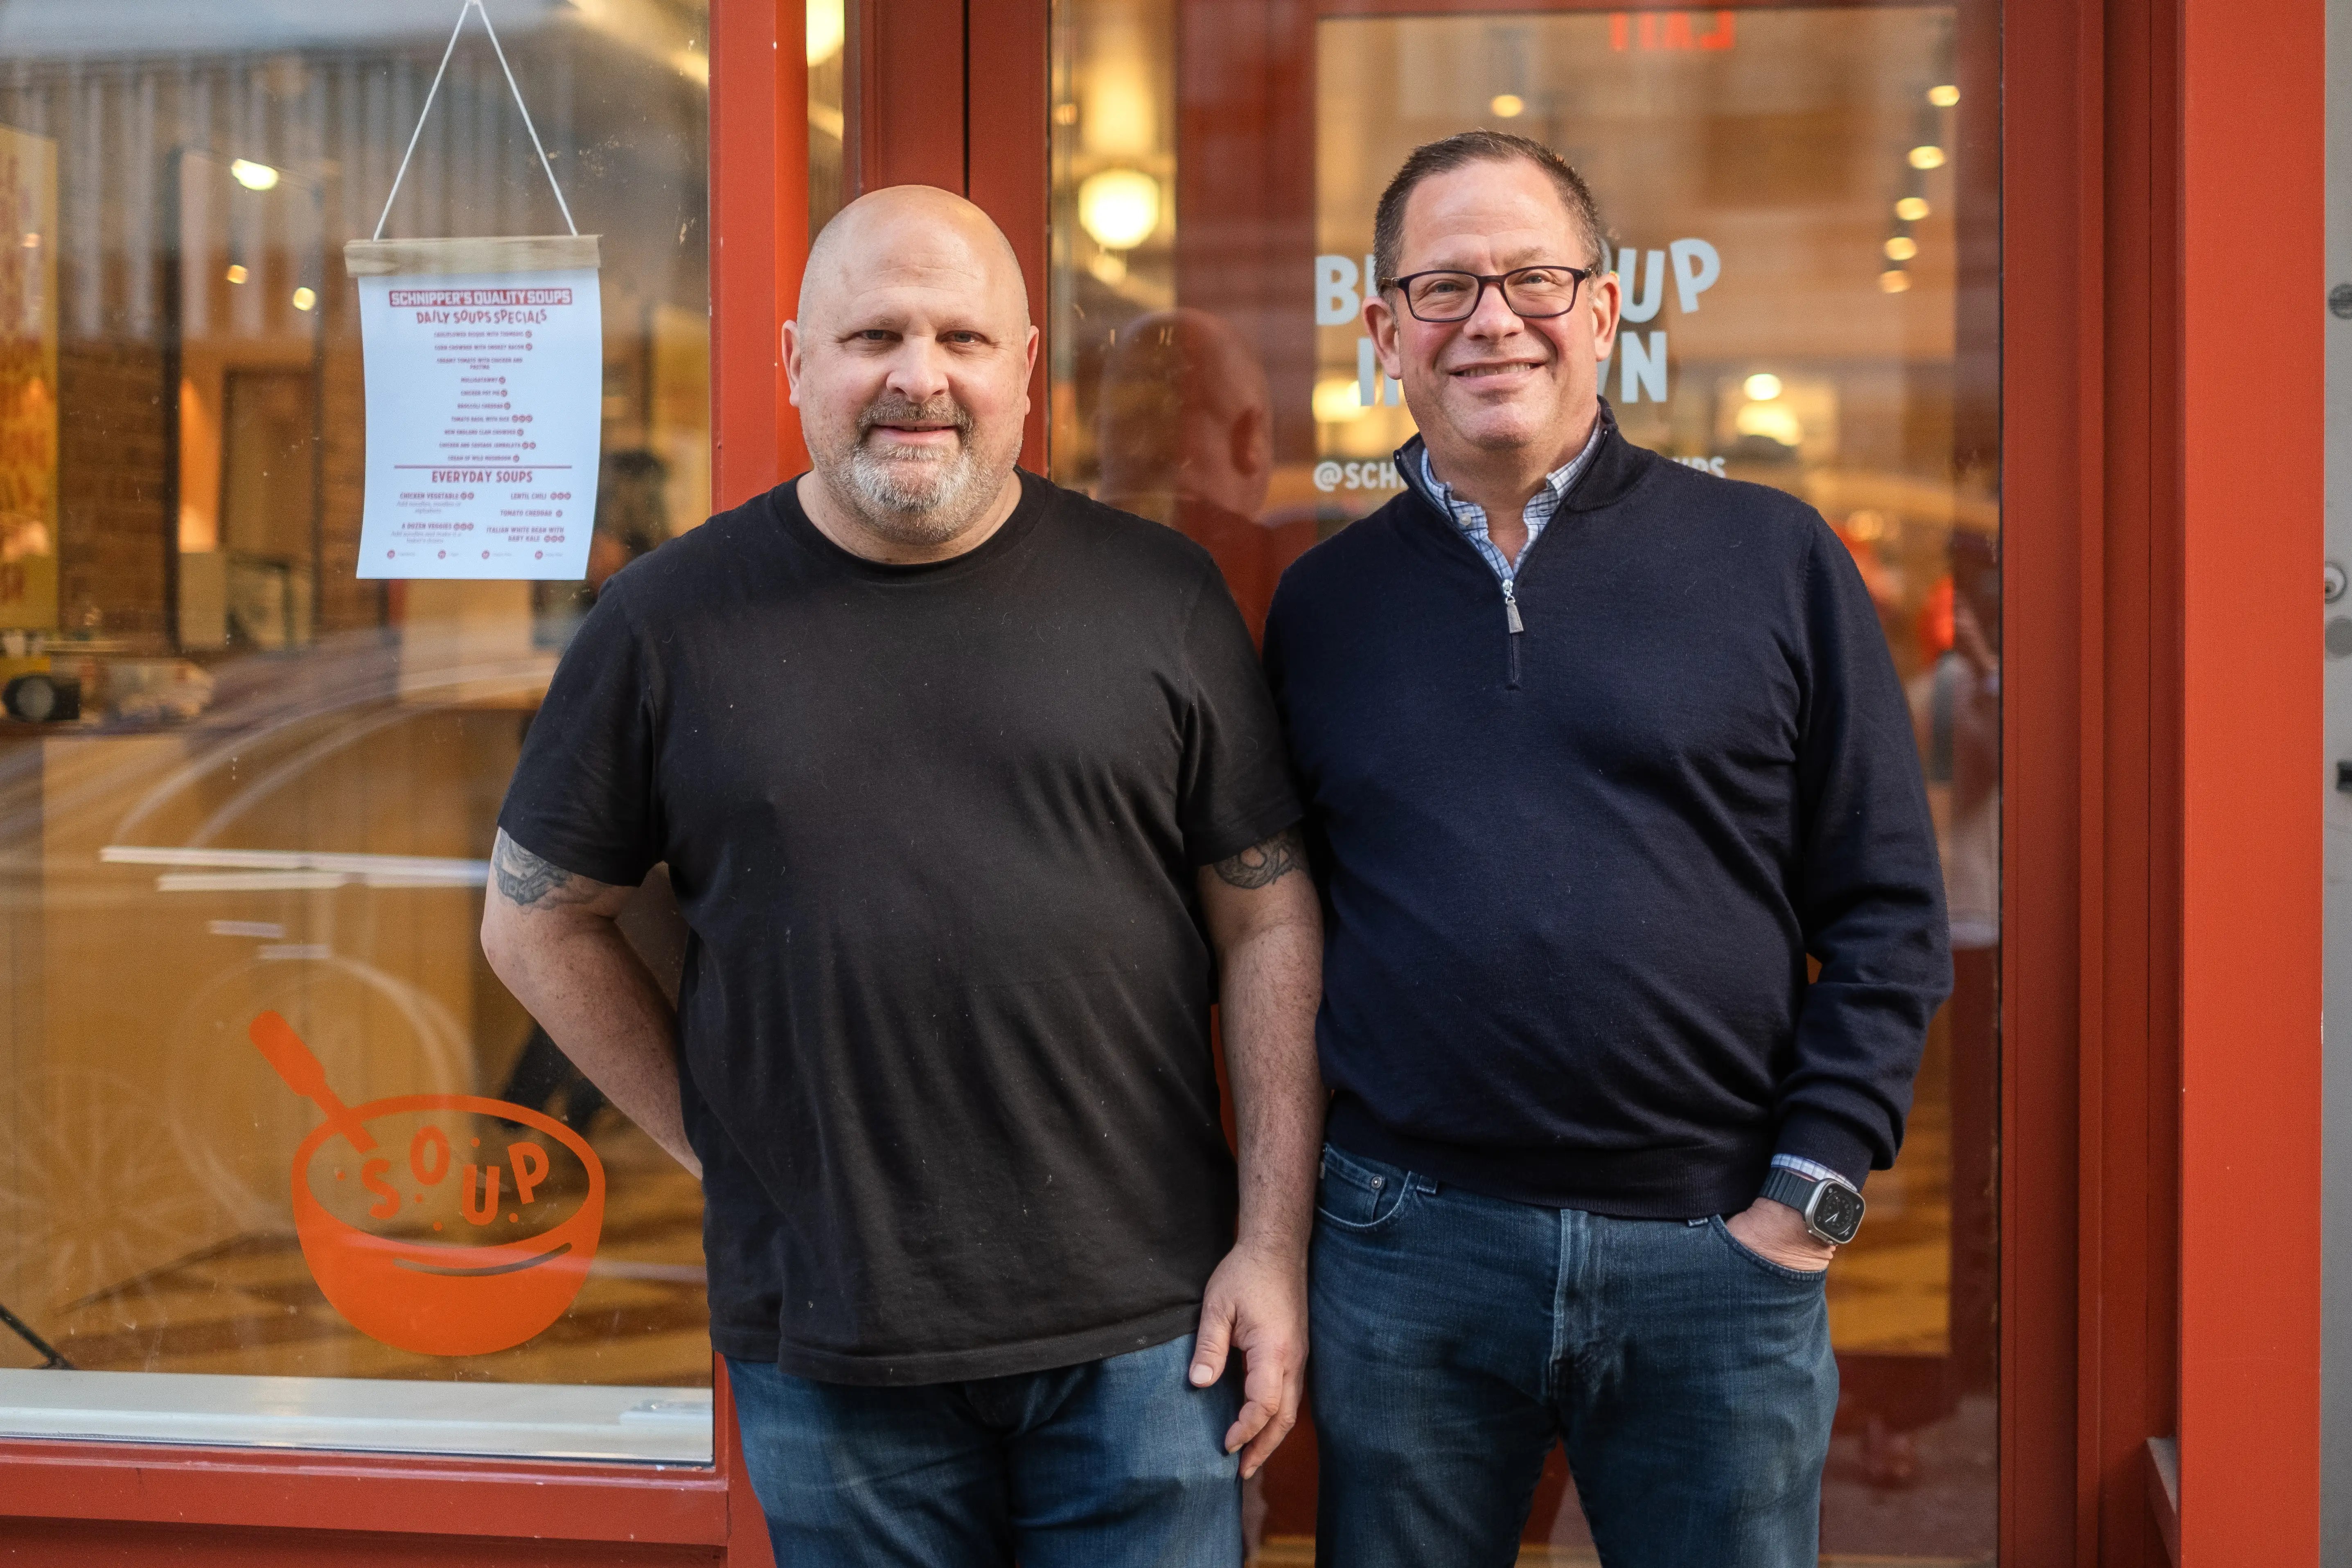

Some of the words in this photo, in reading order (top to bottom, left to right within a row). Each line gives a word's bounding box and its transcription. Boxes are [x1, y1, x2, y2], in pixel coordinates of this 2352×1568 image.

[392, 291, 472, 305] SCHNIPPER'S
[474, 290, 526, 305] QUALITY
[527, 290, 571, 304] SOUPS
[416, 309, 450, 324] DAILY
[453, 309, 492, 324] SOUPS
[494, 309, 548, 324] SPECIALS
[432, 471, 492, 483] EVERYDAY
[496, 471, 533, 483] SOUPS
[361, 1125, 550, 1226] SOUP
